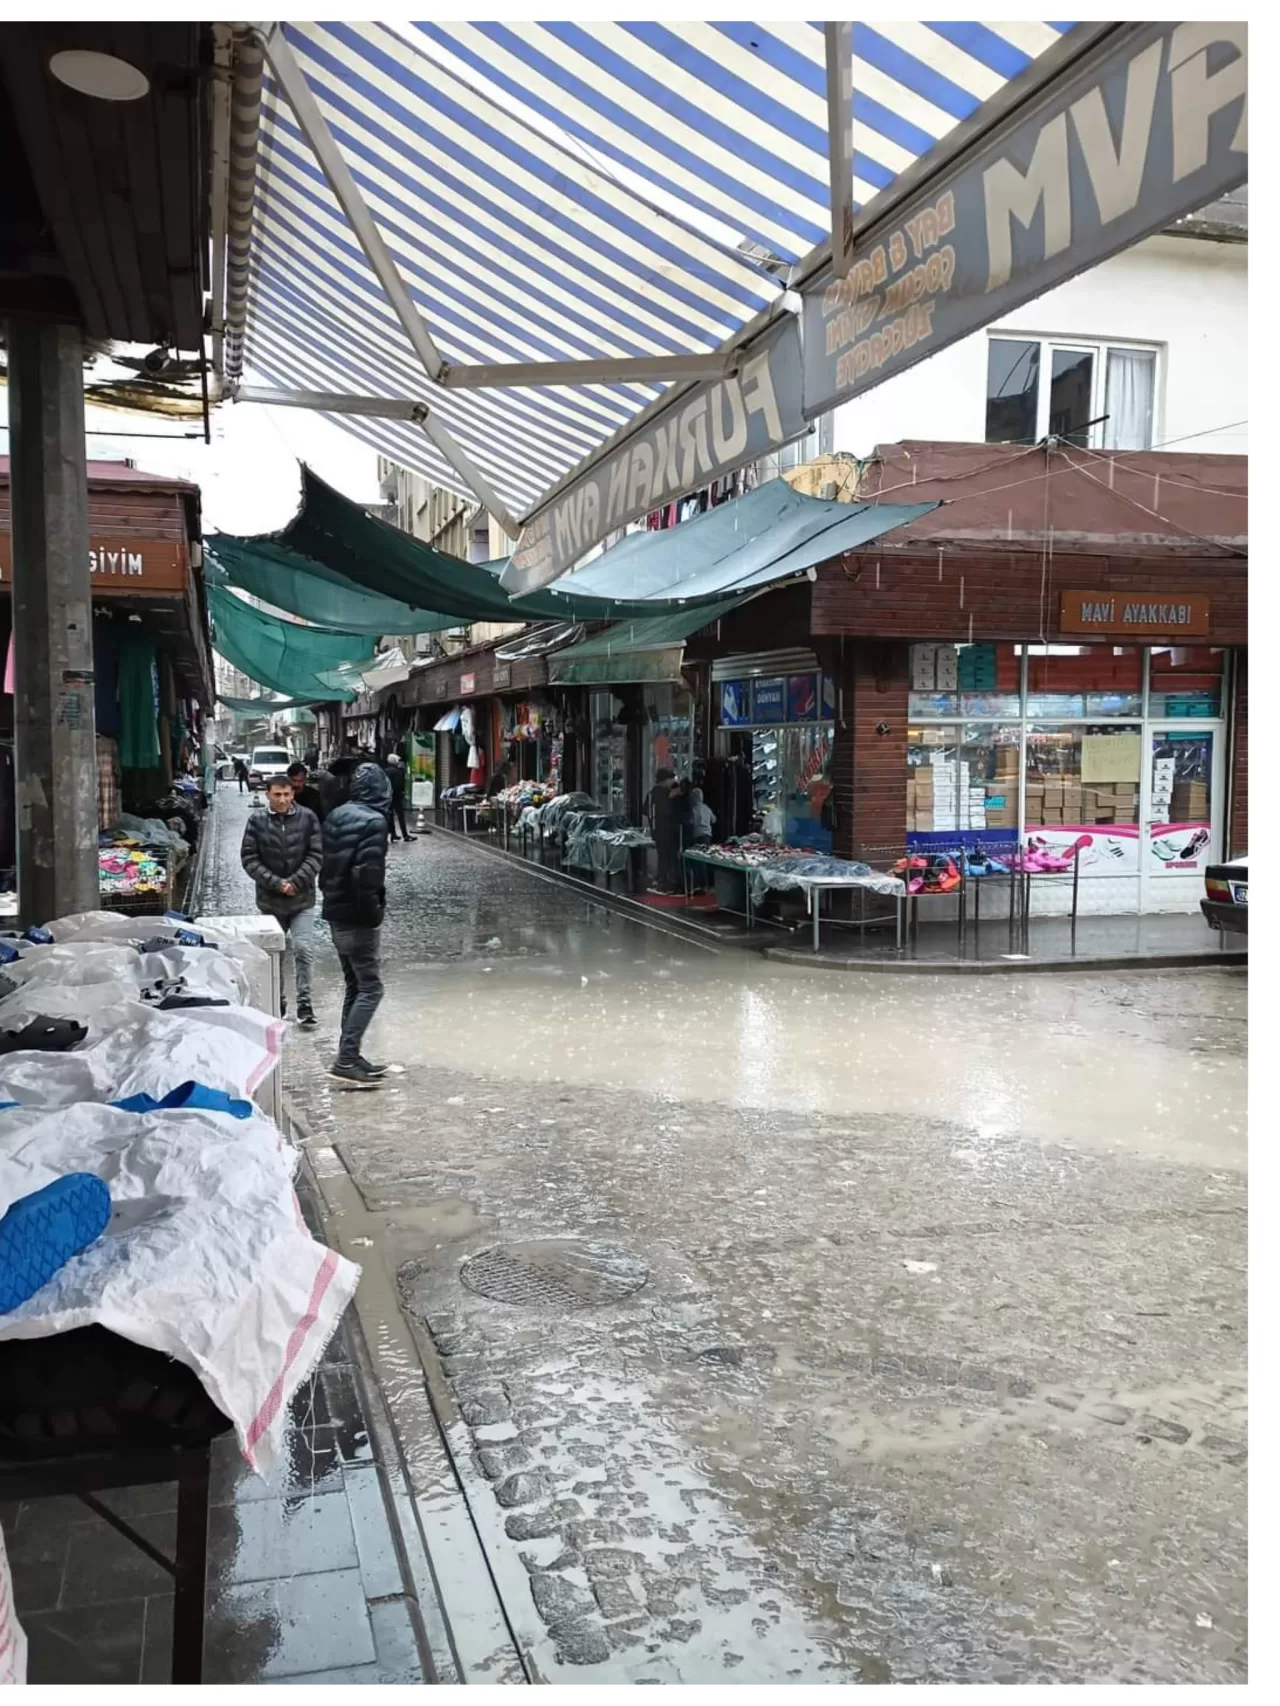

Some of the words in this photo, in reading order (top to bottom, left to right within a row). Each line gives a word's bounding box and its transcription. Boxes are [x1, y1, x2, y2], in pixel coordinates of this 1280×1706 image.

[88, 546, 142, 575] GİYİM
[1081, 598, 1115, 622] MAVİ
[1123, 603, 1192, 624] AYAKKABI
